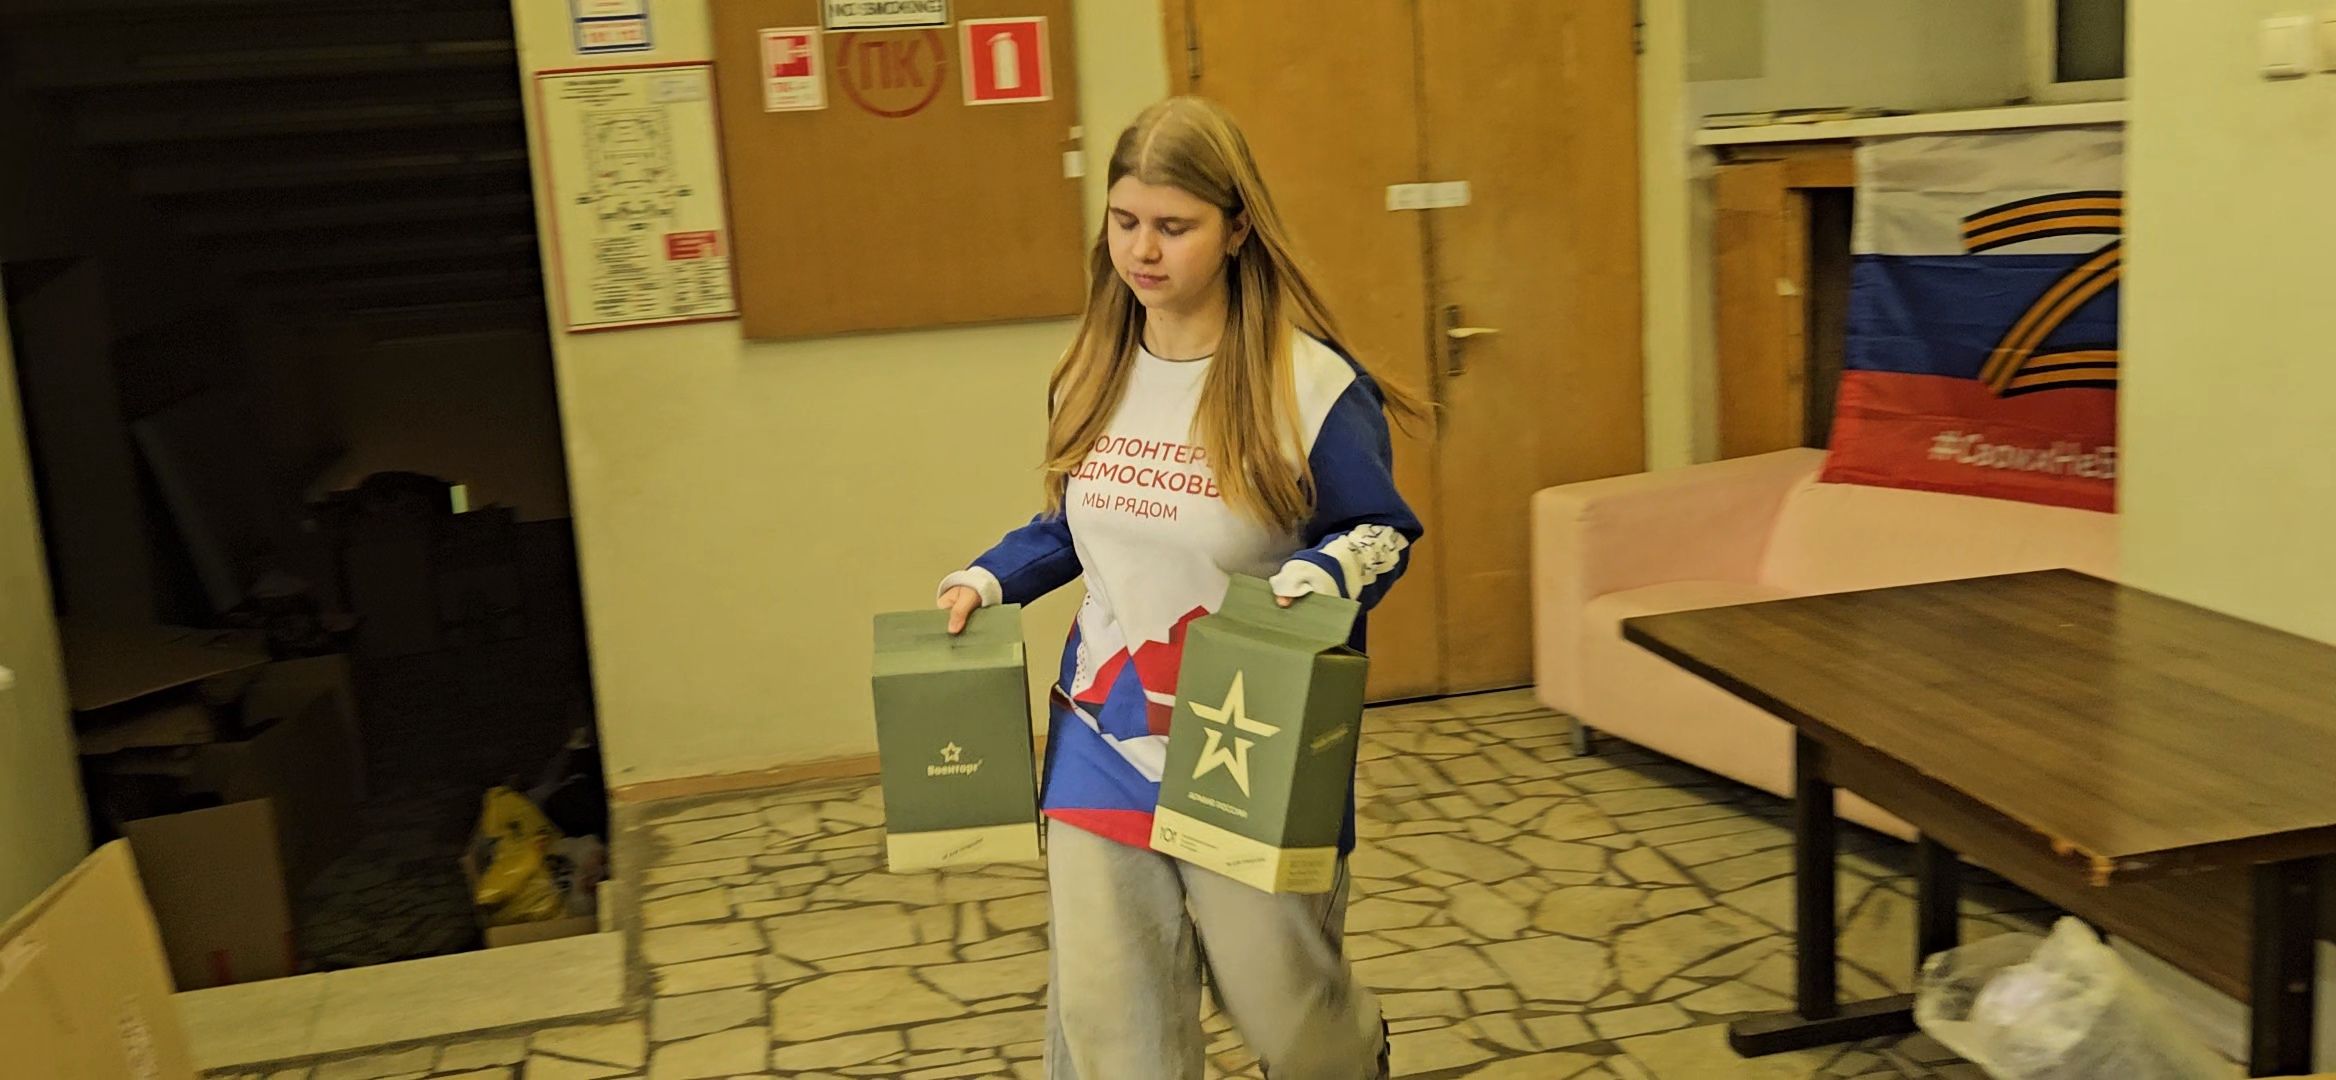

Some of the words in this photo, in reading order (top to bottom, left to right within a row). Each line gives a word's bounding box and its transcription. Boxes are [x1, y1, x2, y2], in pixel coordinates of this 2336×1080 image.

[860, 39, 924, 90] ПК
[1087, 434, 1211, 468] ОЛОНТЕР
[1069, 461, 1220, 498] ОДМОСКОВЬ
[1082, 492, 1111, 509] МЫ
[1114, 495, 1178, 521] РЯДОМ
